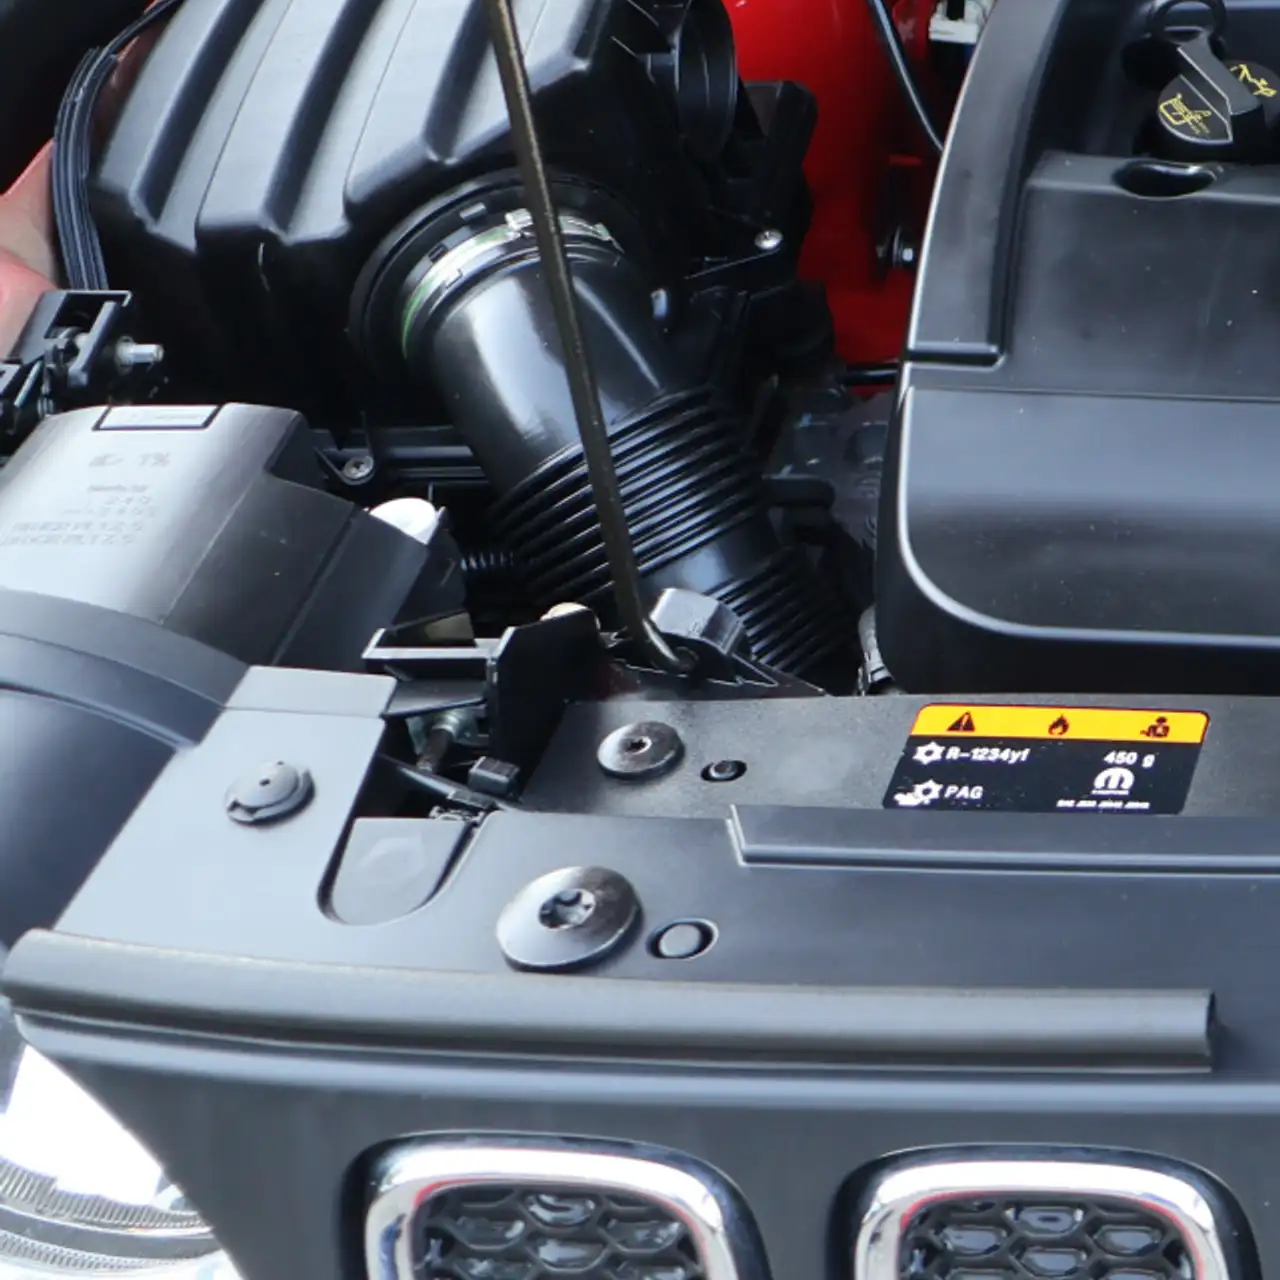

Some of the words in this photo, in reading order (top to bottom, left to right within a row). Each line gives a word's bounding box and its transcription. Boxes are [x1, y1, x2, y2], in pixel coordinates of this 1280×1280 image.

[945, 743, 1031, 764] R-1234yf
[1103, 750, 1138, 766] 450
[943, 784, 984, 801] PAG
